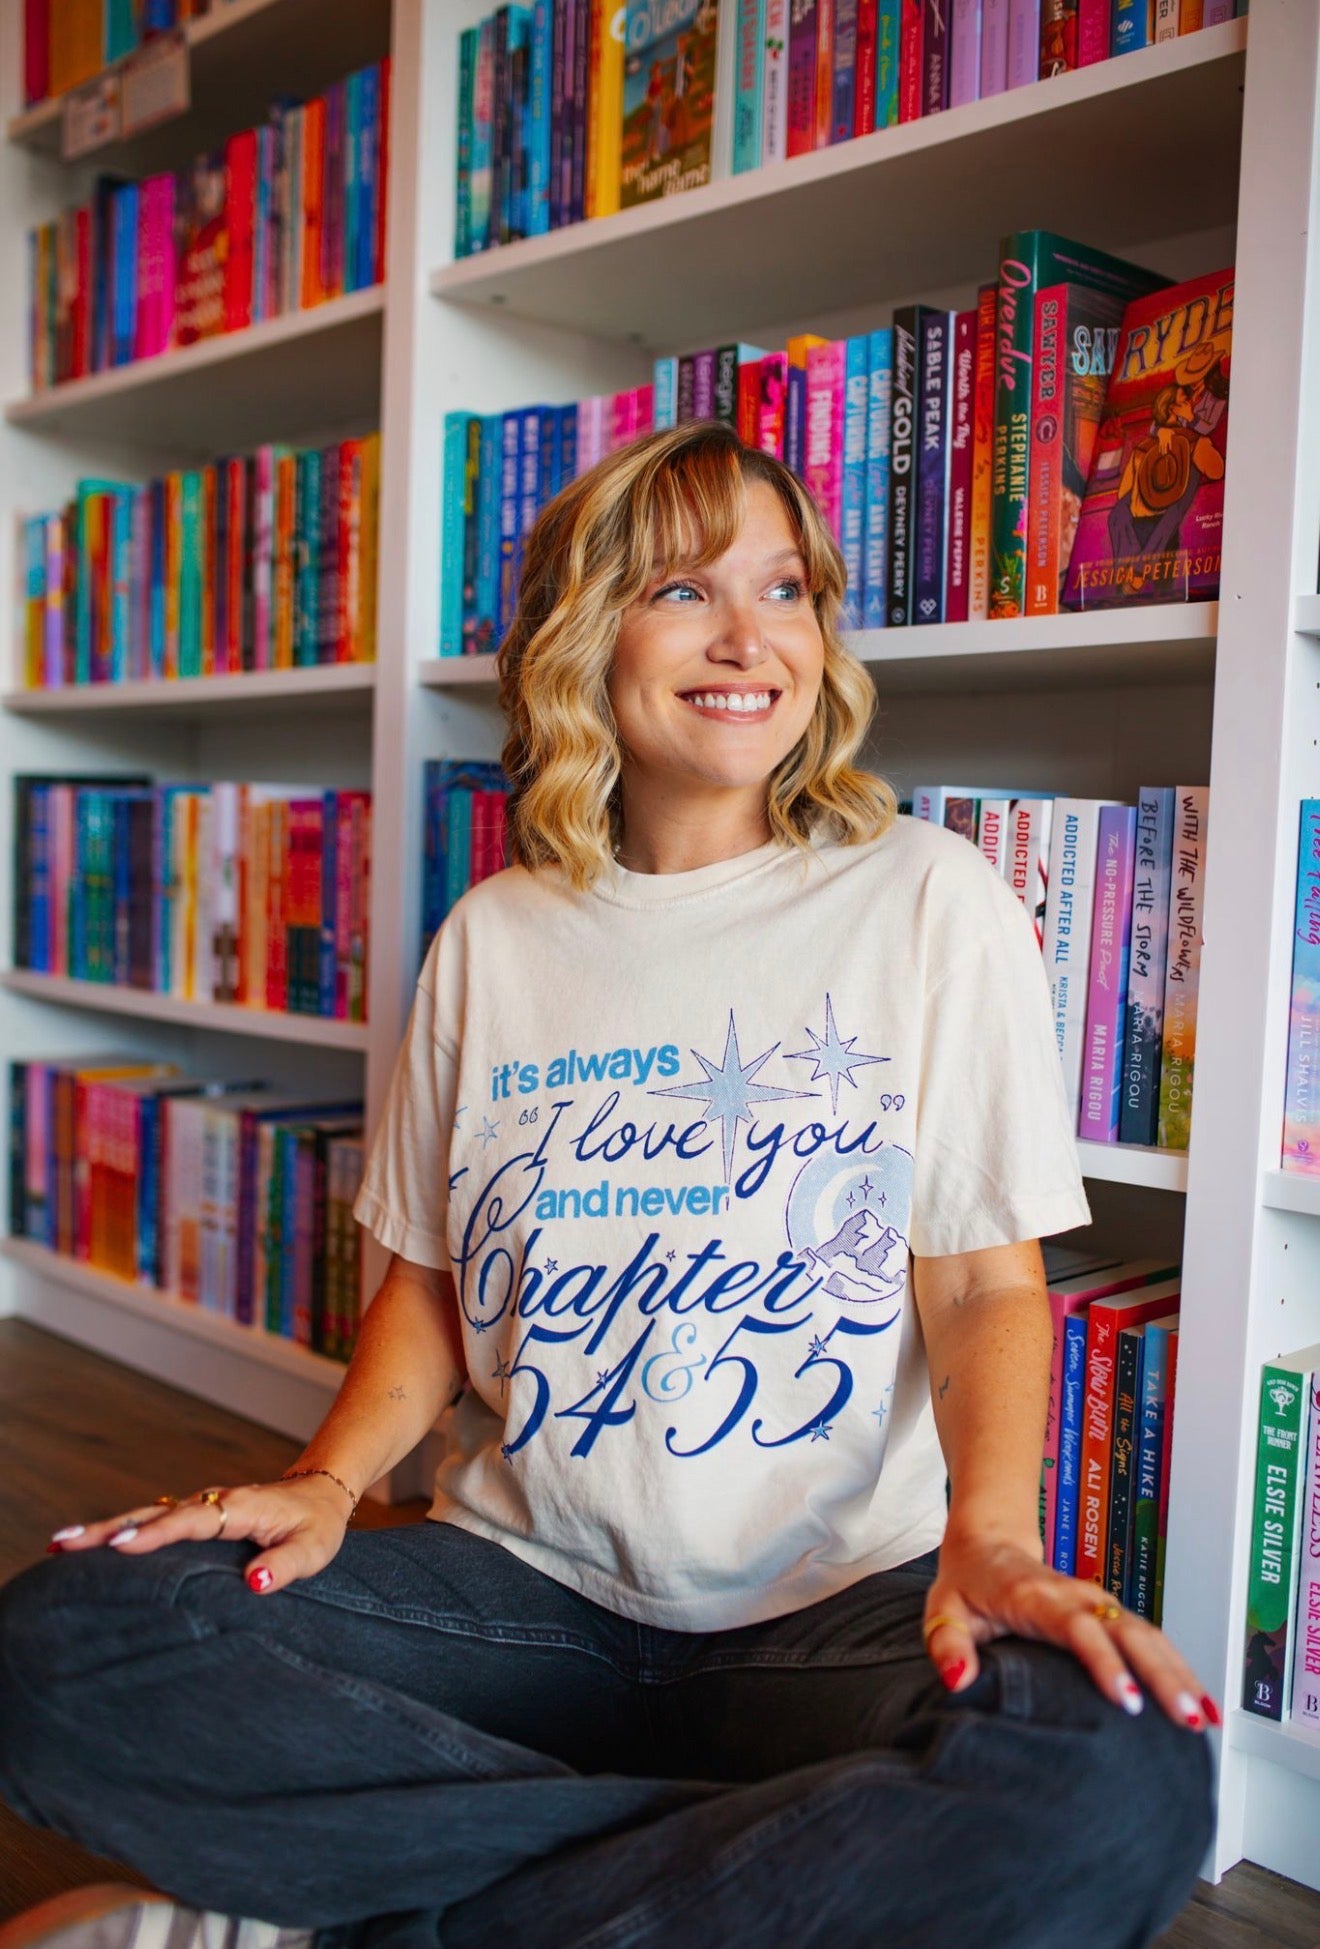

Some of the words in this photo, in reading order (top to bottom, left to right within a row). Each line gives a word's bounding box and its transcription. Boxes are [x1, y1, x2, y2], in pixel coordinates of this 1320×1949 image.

[1000, 259, 1033, 391] Overdue
[1040, 300, 1058, 402] SAWYER
[1120, 282, 1235, 381] RYDE
[926, 326, 943, 391] SABLE
[957, 348, 972, 400] Worth
[976, 332, 995, 384] FINAL
[893, 396, 912, 475] GOLD
[924, 396, 941, 451] PEAK
[953, 423, 971, 450] Try
[994, 425, 1008, 496] PERKINS
[1010, 413, 1027, 503] STEPHANIE
[894, 485, 907, 547] DEVNEY
[923, 478, 937, 535] DEVNEY
[954, 487, 966, 537] VALERIE
[921, 537, 935, 582] PERRY
[952, 539, 964, 587] PEPPER
[1037, 510, 1050, 568] PETERSON
[892, 551, 906, 598] PERRY
[973, 537, 986, 613] PERKINS
[1073, 567, 1135, 590] JESSICA
[983, 811, 1001, 865] ADDIC
[1137, 799, 1159, 871] BEFORE
[1182, 795, 1200, 842] WITH
[1013, 810, 1031, 889] ADDICTED
[1060, 814, 1079, 886] ADDICTED
[1178, 848, 1198, 883] THE
[1057, 890, 1073, 936] AFTER
[1100, 858, 1118, 946] NO-PRESSURE
[1135, 876, 1155, 914] THE
[1055, 939, 1070, 964] ALL
[1132, 922, 1152, 978] STORM
[1057, 976, 1069, 1009] KRISTA
[1131, 990, 1145, 1044] MARIA
[1173, 992, 1186, 1048] MARIA
[1299, 1016, 1312, 1048] JILL
[491, 1059, 539, 1101] it's
[547, 1044, 680, 1088] always
[1091, 1023, 1108, 1070] MARIA
[1087, 1076, 1104, 1121] RIGOU
[1128, 1052, 1142, 1109] RIGOU
[1168, 1056, 1182, 1113] RIGOU
[1296, 1054, 1311, 1123] SHALVIS
[569, 1090, 715, 1163] love
[535, 1186, 609, 1221] and
[614, 1181, 730, 1218] never
[447, 1153, 824, 1356] Chapter
[1066, 1328, 1086, 1373] Seven
[1095, 1322, 1110, 1344] The
[502, 1317, 657, 1460] 54
[640, 1322, 707, 1403] &
[665, 1308, 902, 1459] 55
[1089, 1348, 1113, 1398] Slow
[1064, 1372, 1081, 1427] Summer
[1087, 1392, 1110, 1442] Burn
[1119, 1391, 1135, 1413] All
[1145, 1369, 1160, 1421] TAKE
[1114, 1436, 1134, 1477] Signs
[1144, 1427, 1157, 1439] A
[1263, 1425, 1276, 1437] THE
[1277, 1428, 1298, 1442] FRONT
[1087, 1458, 1103, 1491] ALI
[1141, 1449, 1156, 1499] HIKE
[1265, 1465, 1287, 1517] ELSIE
[1061, 1498, 1071, 1530] JANE
[1084, 1495, 1100, 1559] ROSEN
[1058, 1551, 1069, 1576] ROS
[1139, 1535, 1149, 1570] KATIE
[1261, 1520, 1284, 1584] SILVER
[1137, 1575, 1147, 1614] RUGGL
[1308, 1580, 1320, 1621] ELSIE
[1305, 1624, 1320, 1677] SILVER
